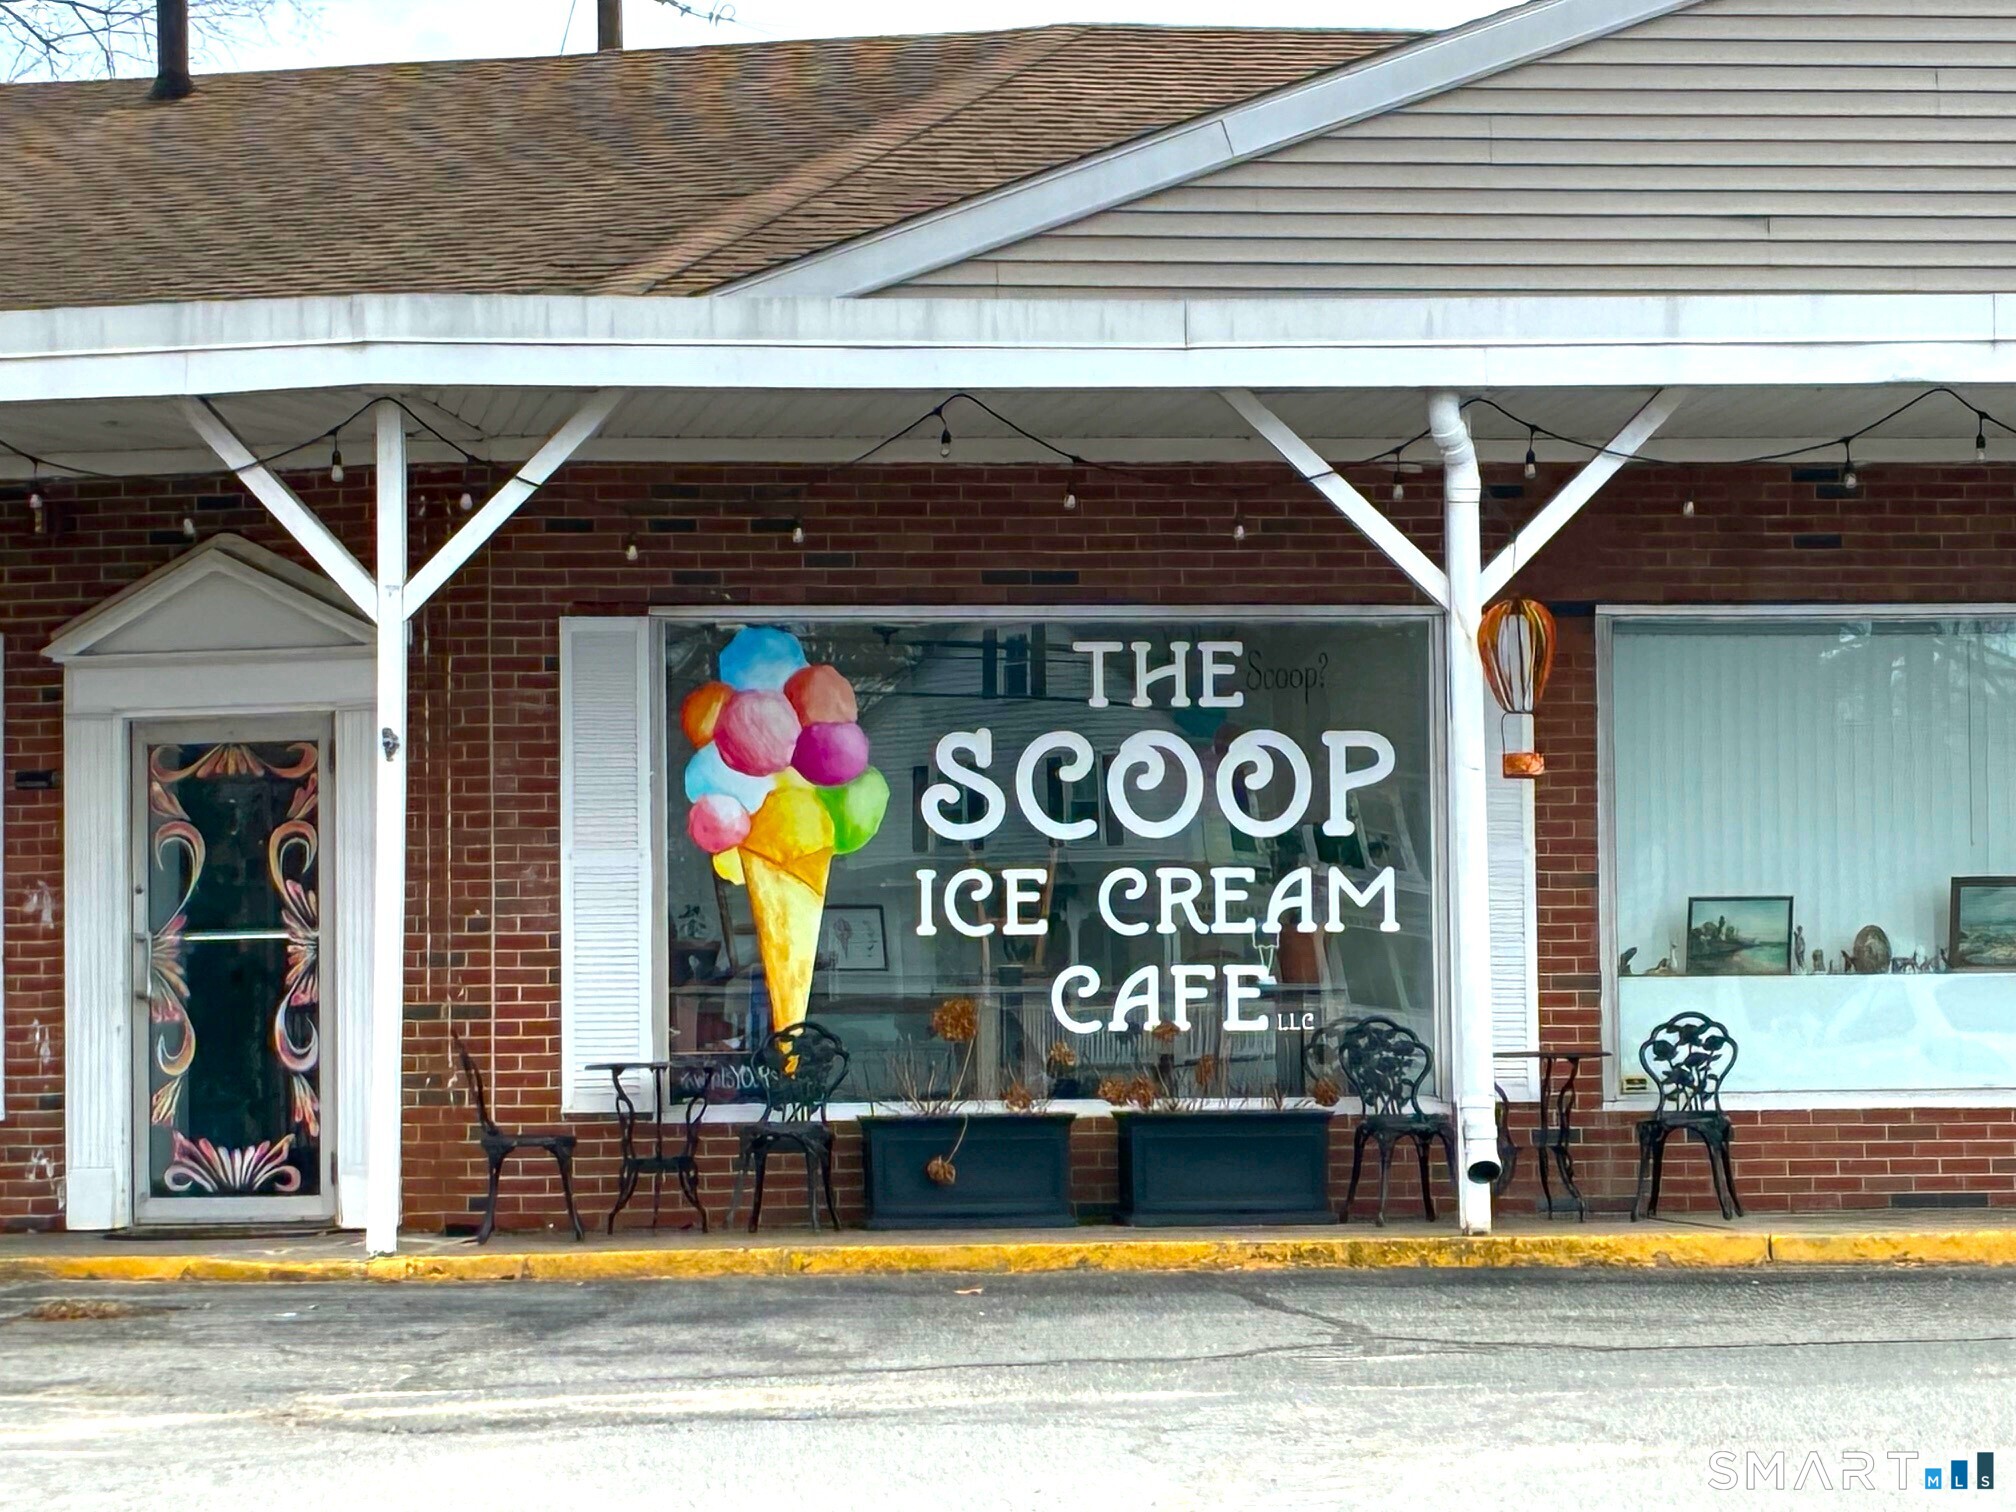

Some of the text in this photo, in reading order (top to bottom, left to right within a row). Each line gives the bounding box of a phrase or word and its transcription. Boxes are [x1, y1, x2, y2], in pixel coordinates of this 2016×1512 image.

[1073, 641, 1243, 708] THE
[1246, 650, 1328, 705] Scoop?
[921, 728, 1395, 840] SCOOP
[916, 867, 1400, 937] ICE CREAM
[1051, 965, 1315, 1034] CAFE LLC
